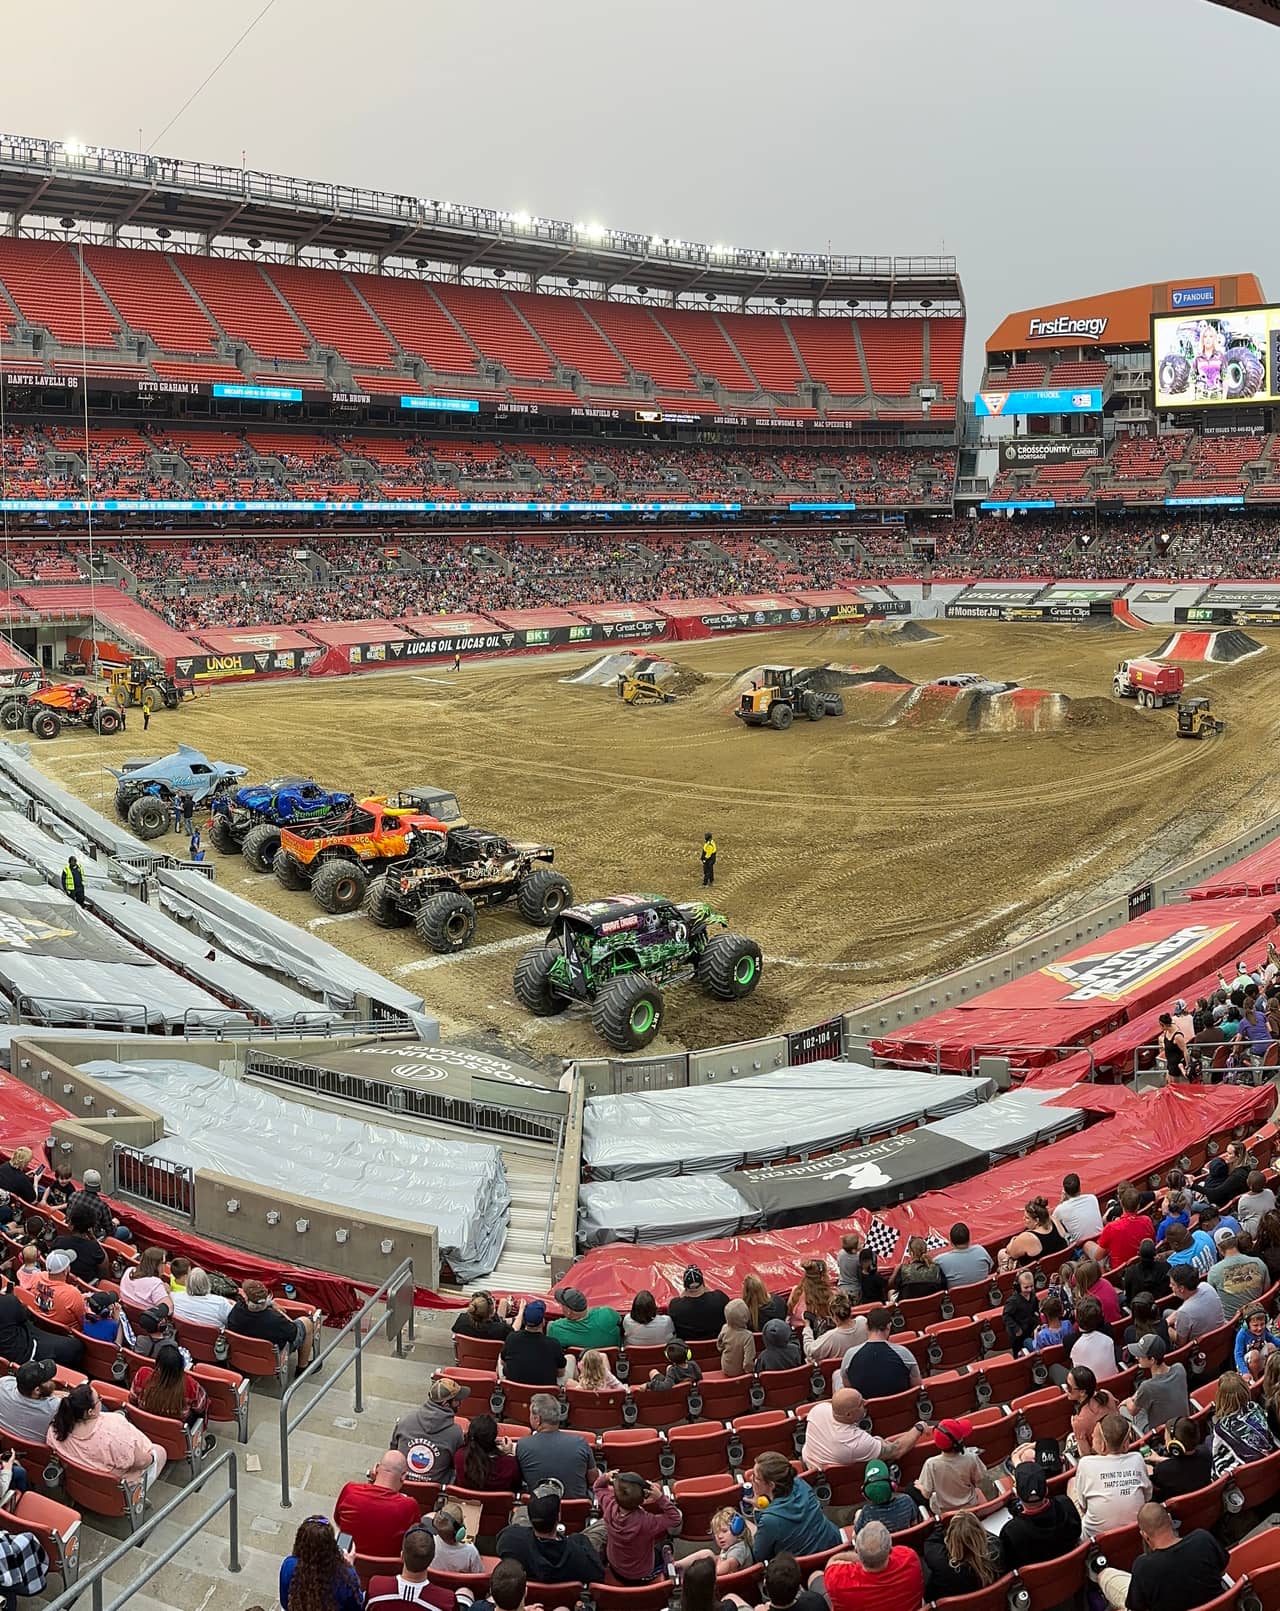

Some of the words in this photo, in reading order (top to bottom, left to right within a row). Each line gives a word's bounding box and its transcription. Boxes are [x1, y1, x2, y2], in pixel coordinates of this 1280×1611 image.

[1183, 292, 1214, 302] FANDUEL
[1029, 316, 1108, 337] FirstEnergy
[7, 374, 33, 385] DANTE
[35, 375, 65, 386] LAVELLI
[68, 377, 78, 387] 86
[138, 382, 158, 391] OTTO
[159, 382, 189, 392] GRAHAM
[190, 384, 199, 394] 14
[332, 393, 348, 402] PAUL
[1017, 446, 1071, 455] CROSSCOUNTRY
[959, 592, 1010, 600] LUCAS
[837, 605, 858, 614] UNOH
[1050, 607, 1071, 616] Great
[1072, 607, 1091, 617] Clips
[701, 616, 720, 624] Great
[720, 614, 737, 623] Clips
[615, 623, 635, 632] Great
[636, 621, 654, 631] Clips
[526, 630, 550, 643] BKT
[569, 627, 592, 639] BKT
[407, 641, 436, 655] LUCAS
[438, 639, 453, 652] OIL
[455, 637, 485, 651] LUCAS
[486, 635, 499, 648] OIL
[206, 656, 242, 670] UNOH
[1060, 925, 1209, 1001] MONSTER
[651, 1012, 660, 1030] BKT
[402, 1045, 511, 1070] MORTGAGE
[890, 1136, 916, 1149] St.
[748, 1155, 847, 1183] Children's
[407, 1437, 441, 1457] CLEVELAND
[1100, 1472, 1115, 1480] TRYING
[1104, 1481, 1118, 1489] THAT'S
[1120, 1488, 1131, 1496] FREE
